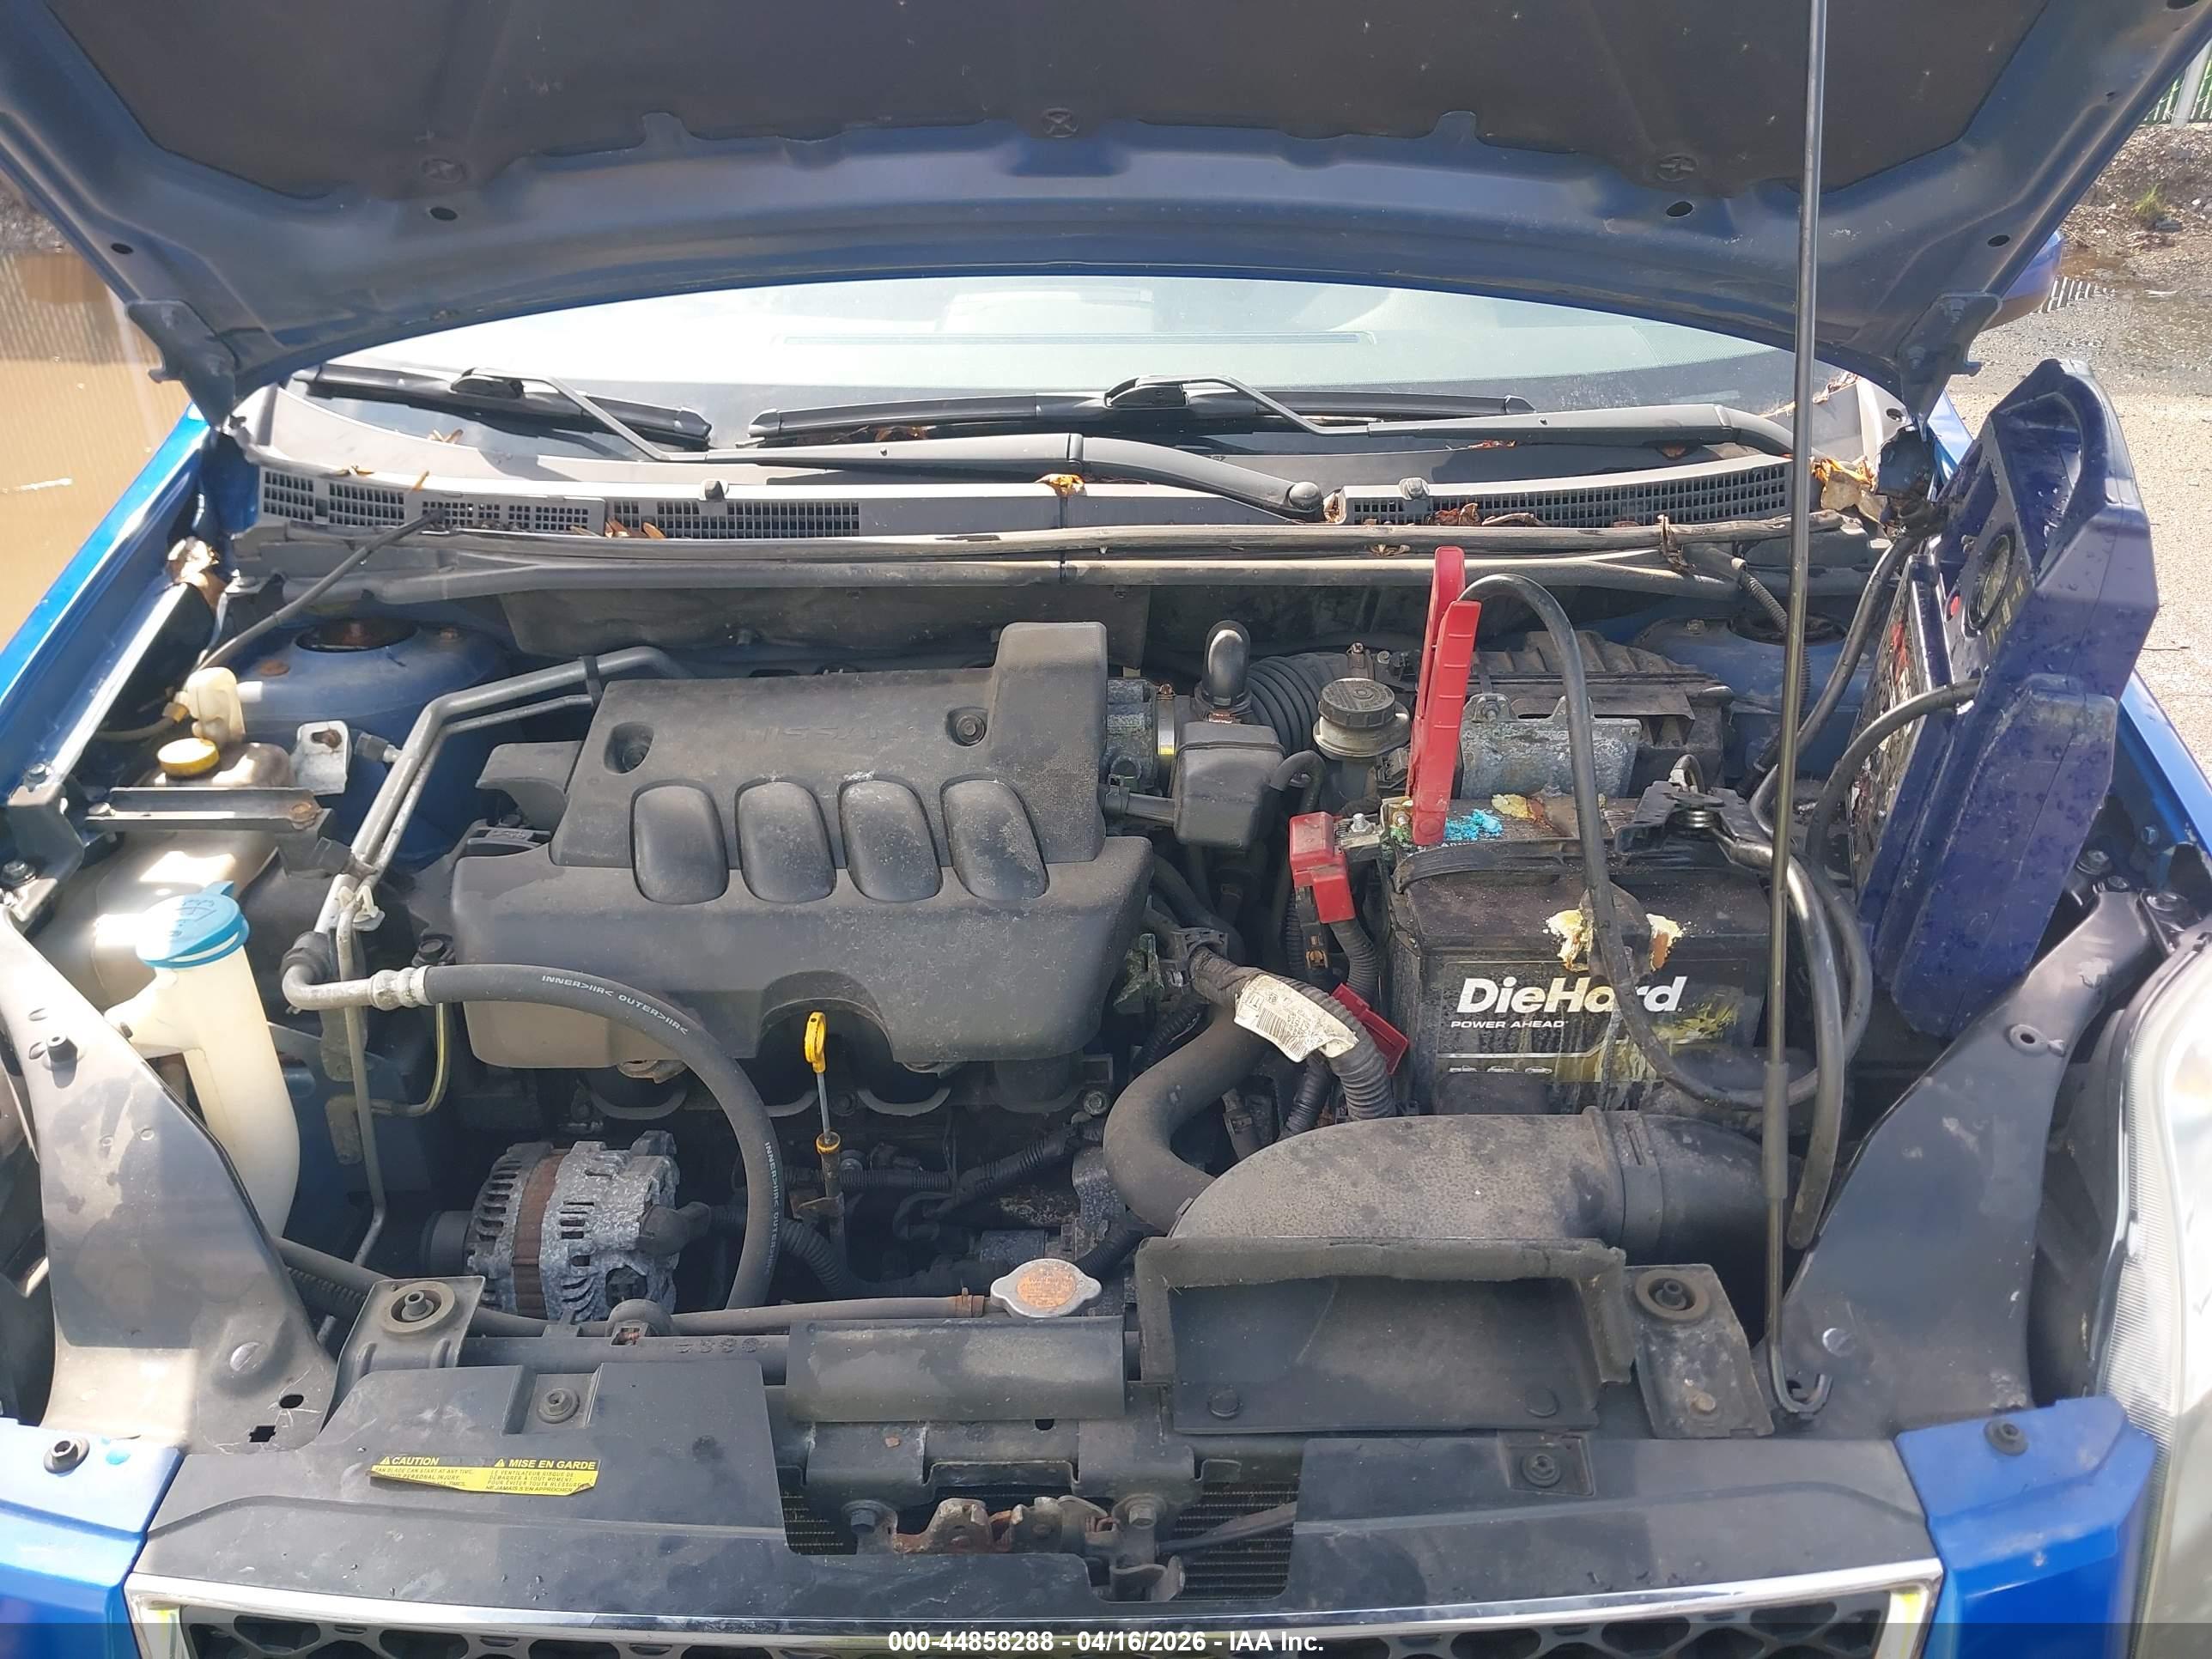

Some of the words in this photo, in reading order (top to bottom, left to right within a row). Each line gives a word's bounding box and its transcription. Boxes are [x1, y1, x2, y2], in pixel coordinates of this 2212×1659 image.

[1451, 1020, 1505, 1029] POWER
[1510, 1020, 1565, 1029] AHEAD
[392, 1456, 440, 1465] CAUTION
[508, 1459, 537, 1468] MISE
[538, 1460, 555, 1468] EN
[556, 1461, 596, 1470] GARDE
